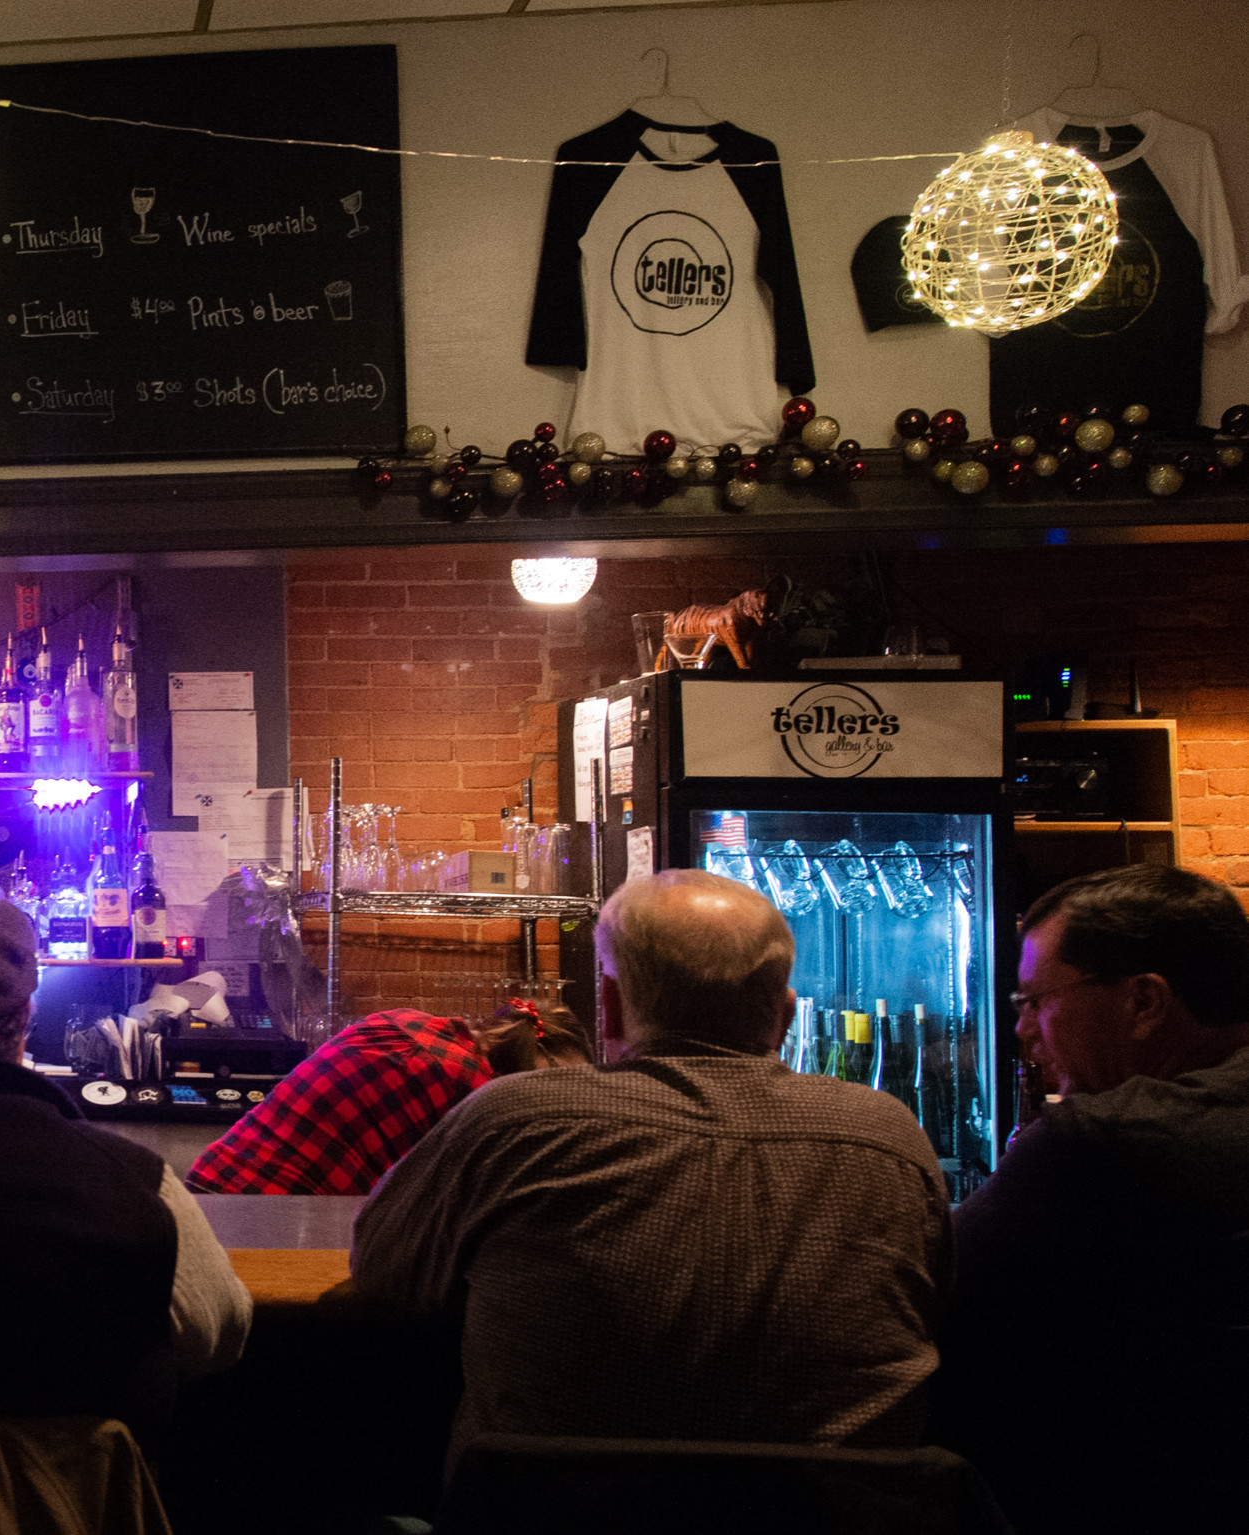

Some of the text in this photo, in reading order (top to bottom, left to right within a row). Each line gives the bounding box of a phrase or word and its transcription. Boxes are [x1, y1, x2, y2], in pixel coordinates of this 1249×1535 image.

[10, 206, 317, 258] Thursday Wine specials
[641, 255, 726, 297] tellers
[21, 300, 91, 339] Friday
[187, 296, 245, 330] Pints
[268, 292, 319, 322] beer
[25, 375, 116, 424] Saturday
[192, 376, 256, 408] Shots
[770, 706, 900, 736] tellers
[825, 735, 895, 756] gallery & bar
